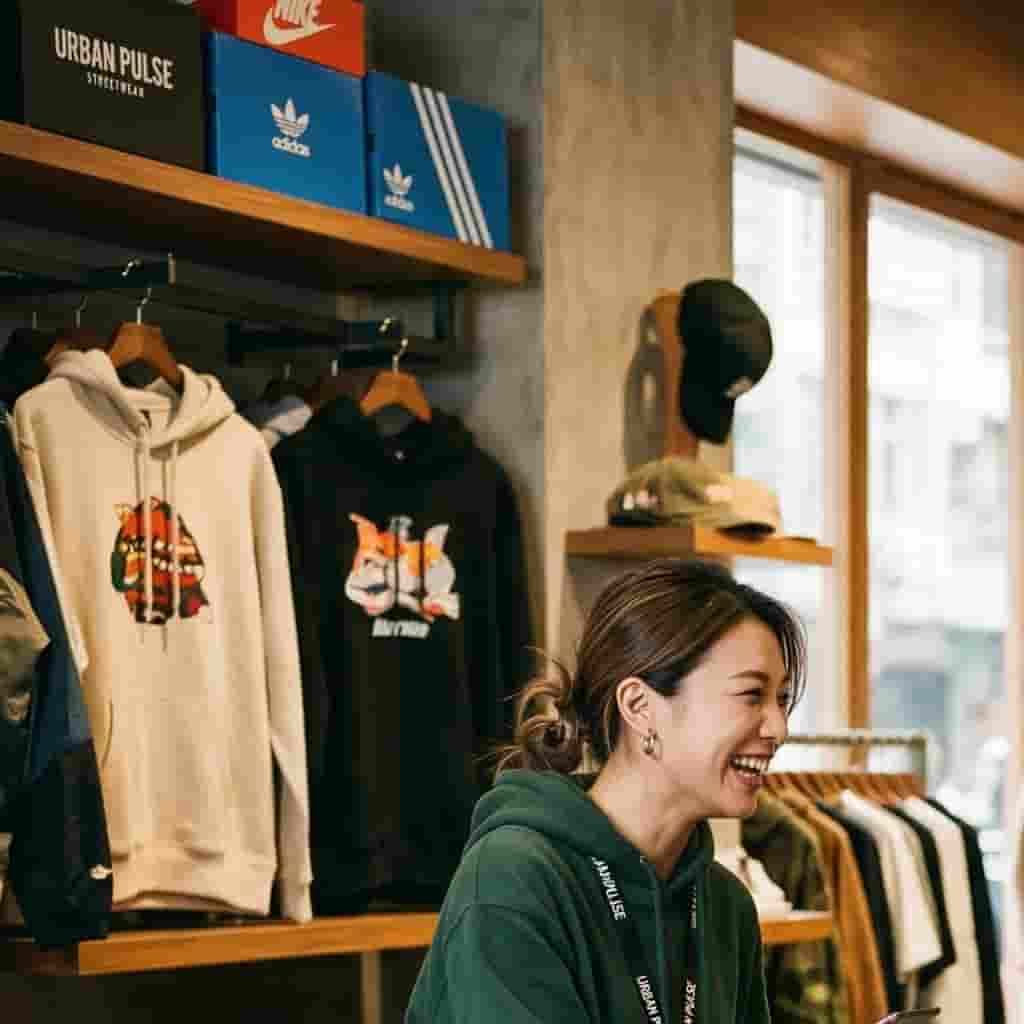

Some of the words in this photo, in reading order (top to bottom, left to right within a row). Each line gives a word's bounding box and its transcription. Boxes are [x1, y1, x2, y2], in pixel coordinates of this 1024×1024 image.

[54, 26, 116, 73] URBAN
[119, 46, 175, 90] PULSE
[271, 135, 312, 158] adidas
[636, 975, 661, 1022] URBAN
